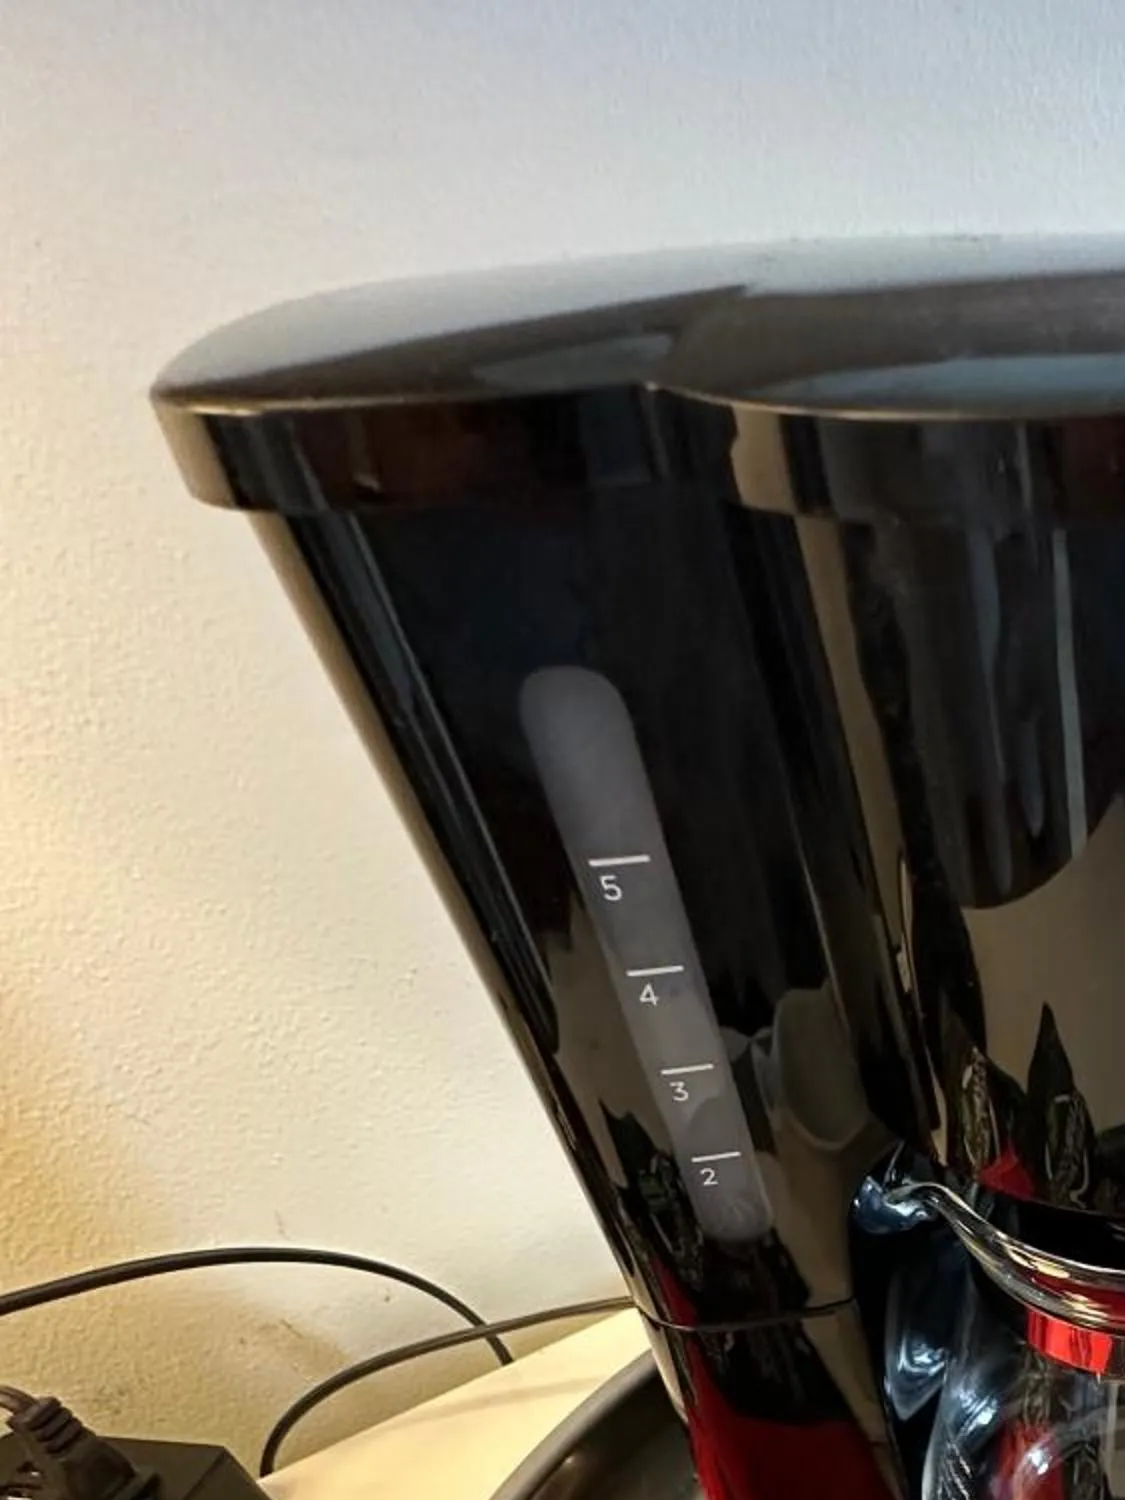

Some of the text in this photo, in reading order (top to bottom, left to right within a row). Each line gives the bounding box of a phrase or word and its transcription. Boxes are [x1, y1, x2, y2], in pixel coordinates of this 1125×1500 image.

[600, 874, 623, 902] 5
[638, 982, 660, 1007] 4
[671, 1080, 690, 1103] 3
[700, 1166, 718, 1187] 2
